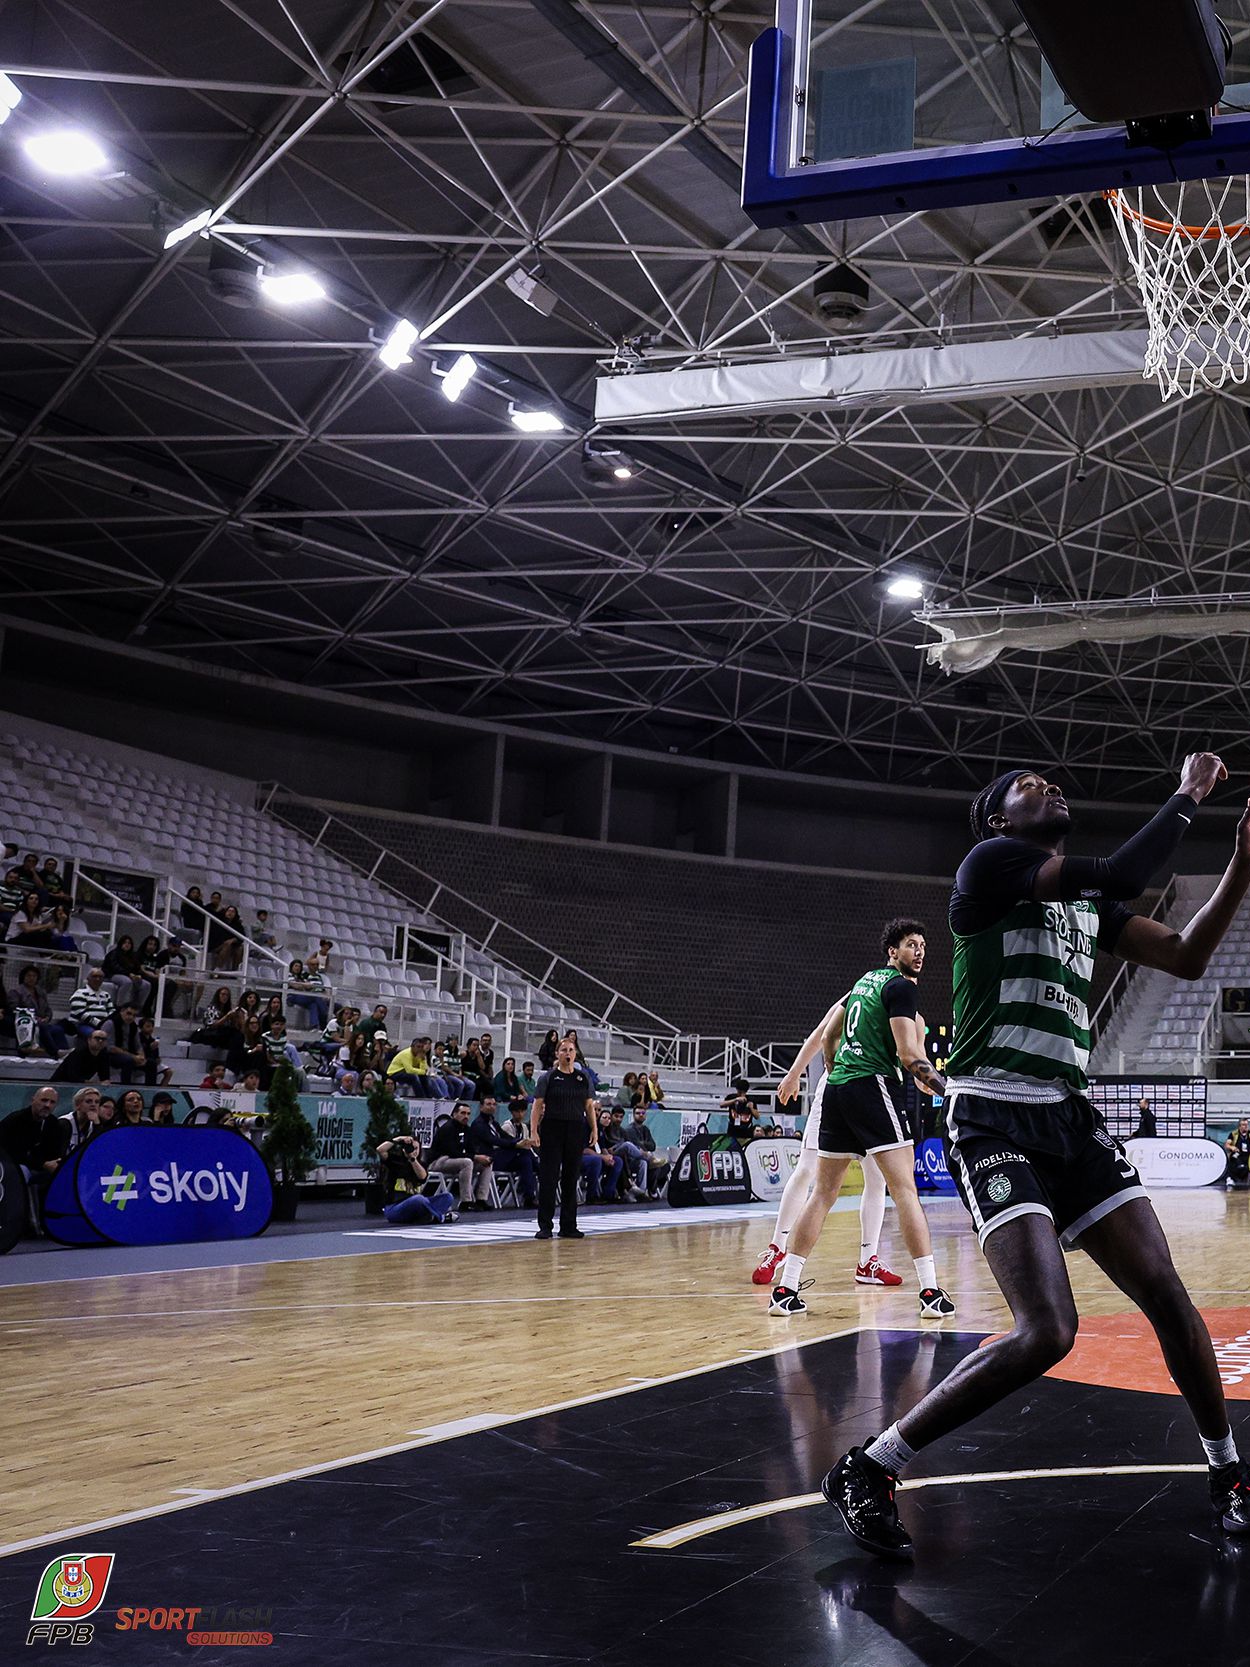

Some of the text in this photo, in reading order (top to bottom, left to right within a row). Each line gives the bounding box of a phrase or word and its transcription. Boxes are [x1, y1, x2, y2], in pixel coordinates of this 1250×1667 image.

[846, 1000, 861, 1039] 0
[317, 1117, 344, 1139] HUGO
[315, 1140, 353, 1160] SANTOS
[975, 1151, 1031, 1171] FIDELIDAD
[1158, 1150, 1215, 1160] GONDOMAR
[711, 1151, 744, 1180] FPB
[149, 1162, 249, 1212] skoiy
